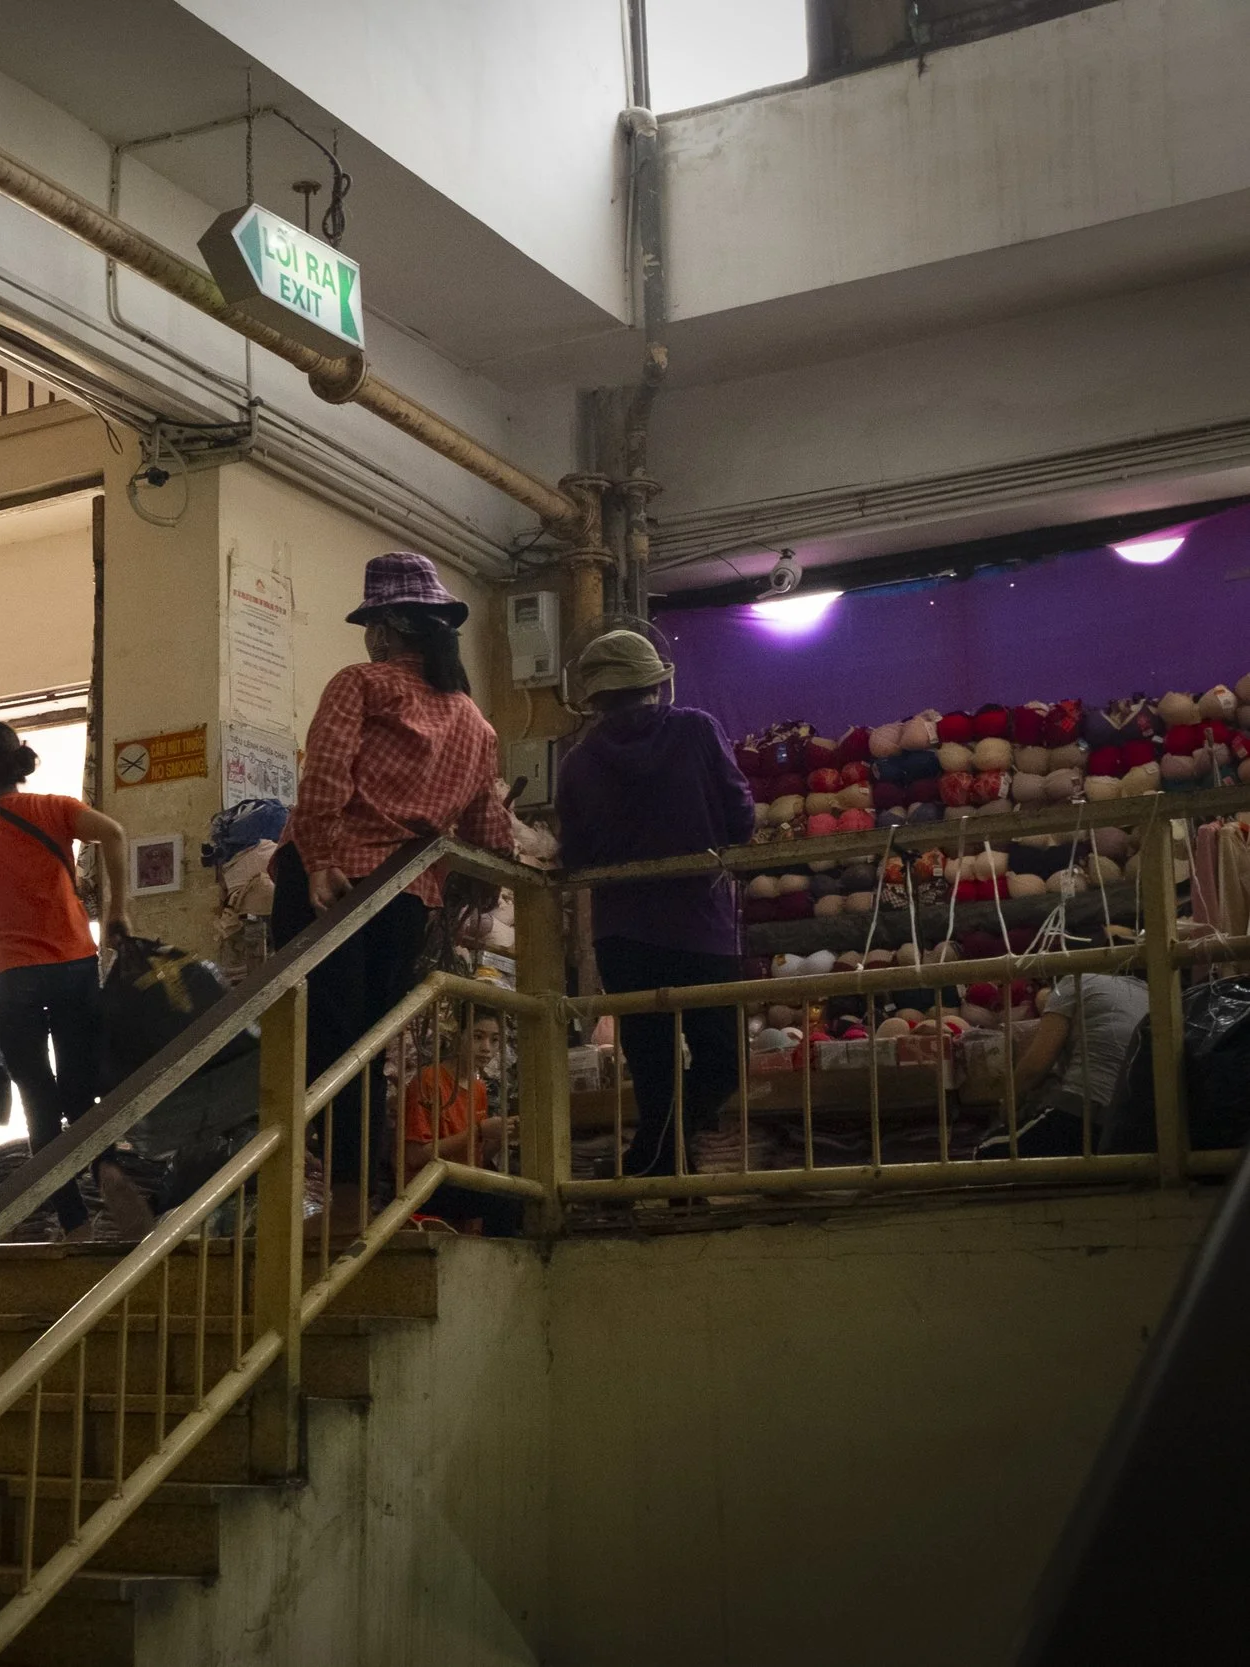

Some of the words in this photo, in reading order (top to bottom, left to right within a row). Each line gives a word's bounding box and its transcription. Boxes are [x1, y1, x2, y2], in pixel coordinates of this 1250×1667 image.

[280, 273, 322, 318] EXIT
[305, 251, 337, 296] RA
[151, 763, 165, 780] NO
[165, 757, 205, 778] SMOKING
